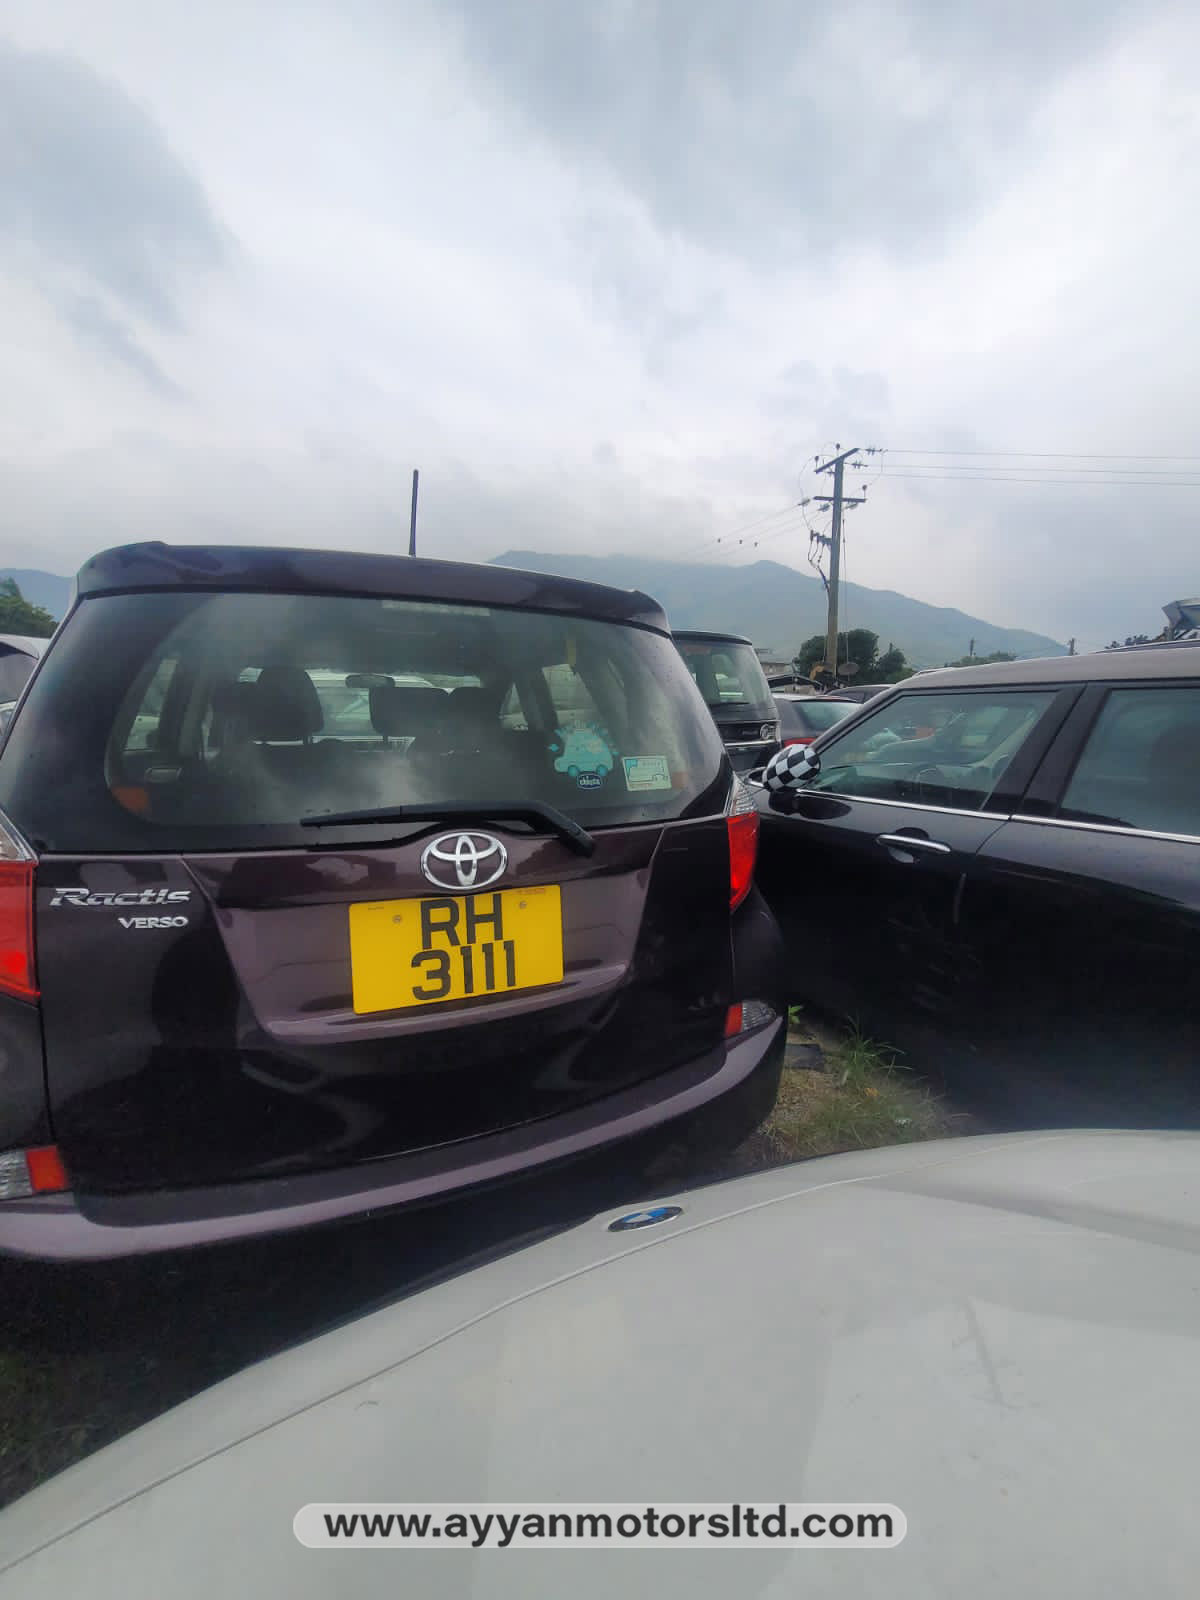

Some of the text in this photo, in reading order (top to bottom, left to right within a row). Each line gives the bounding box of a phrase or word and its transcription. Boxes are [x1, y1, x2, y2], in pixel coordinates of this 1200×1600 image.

[49, 888, 191, 906] Ractis
[118, 916, 189, 929] VERSO
[420, 893, 503, 949] RH
[411, 940, 516, 1000] 3111
